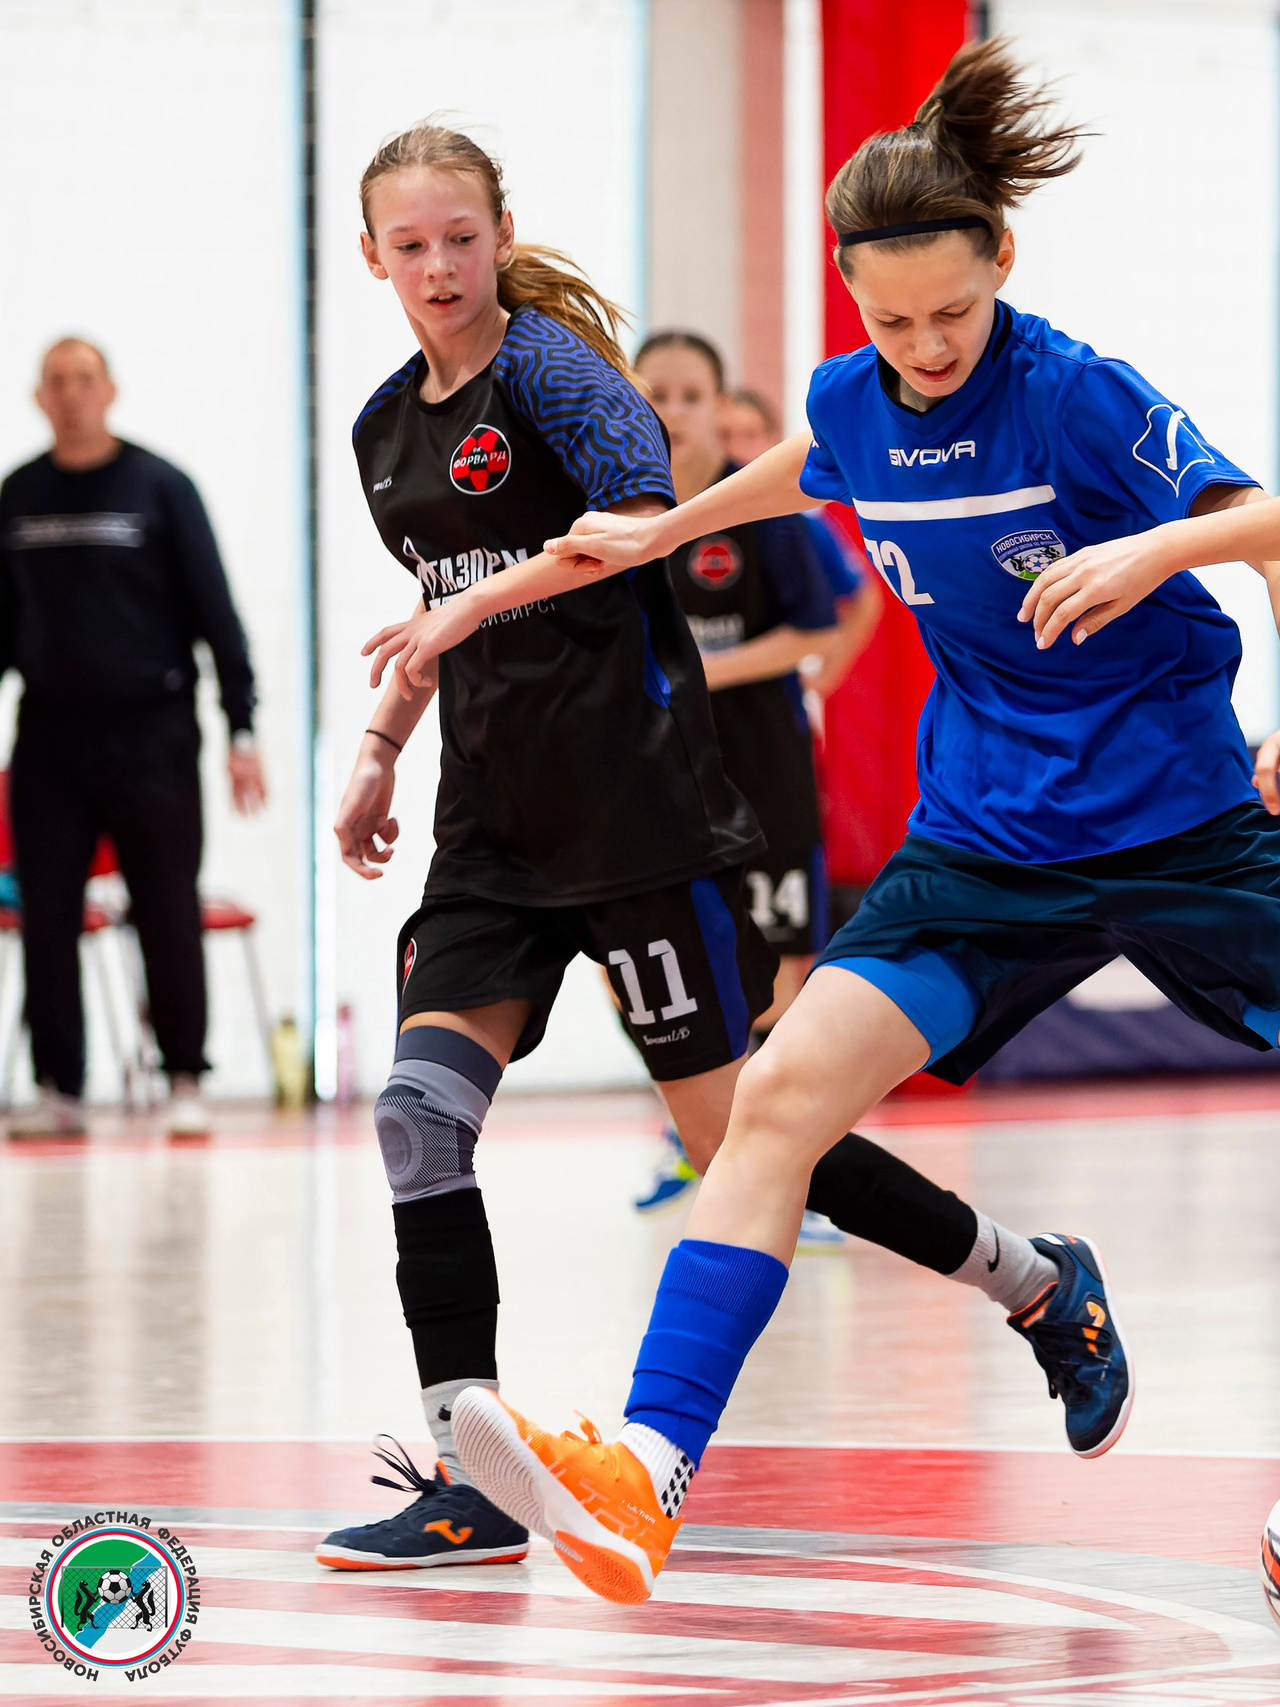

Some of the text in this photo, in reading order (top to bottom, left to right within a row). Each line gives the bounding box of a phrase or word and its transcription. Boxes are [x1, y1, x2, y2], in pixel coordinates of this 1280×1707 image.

[995, 533, 1053, 554] НОВОСИБИРСК
[746, 868, 808, 928] 14
[608, 938, 698, 1025] 11
